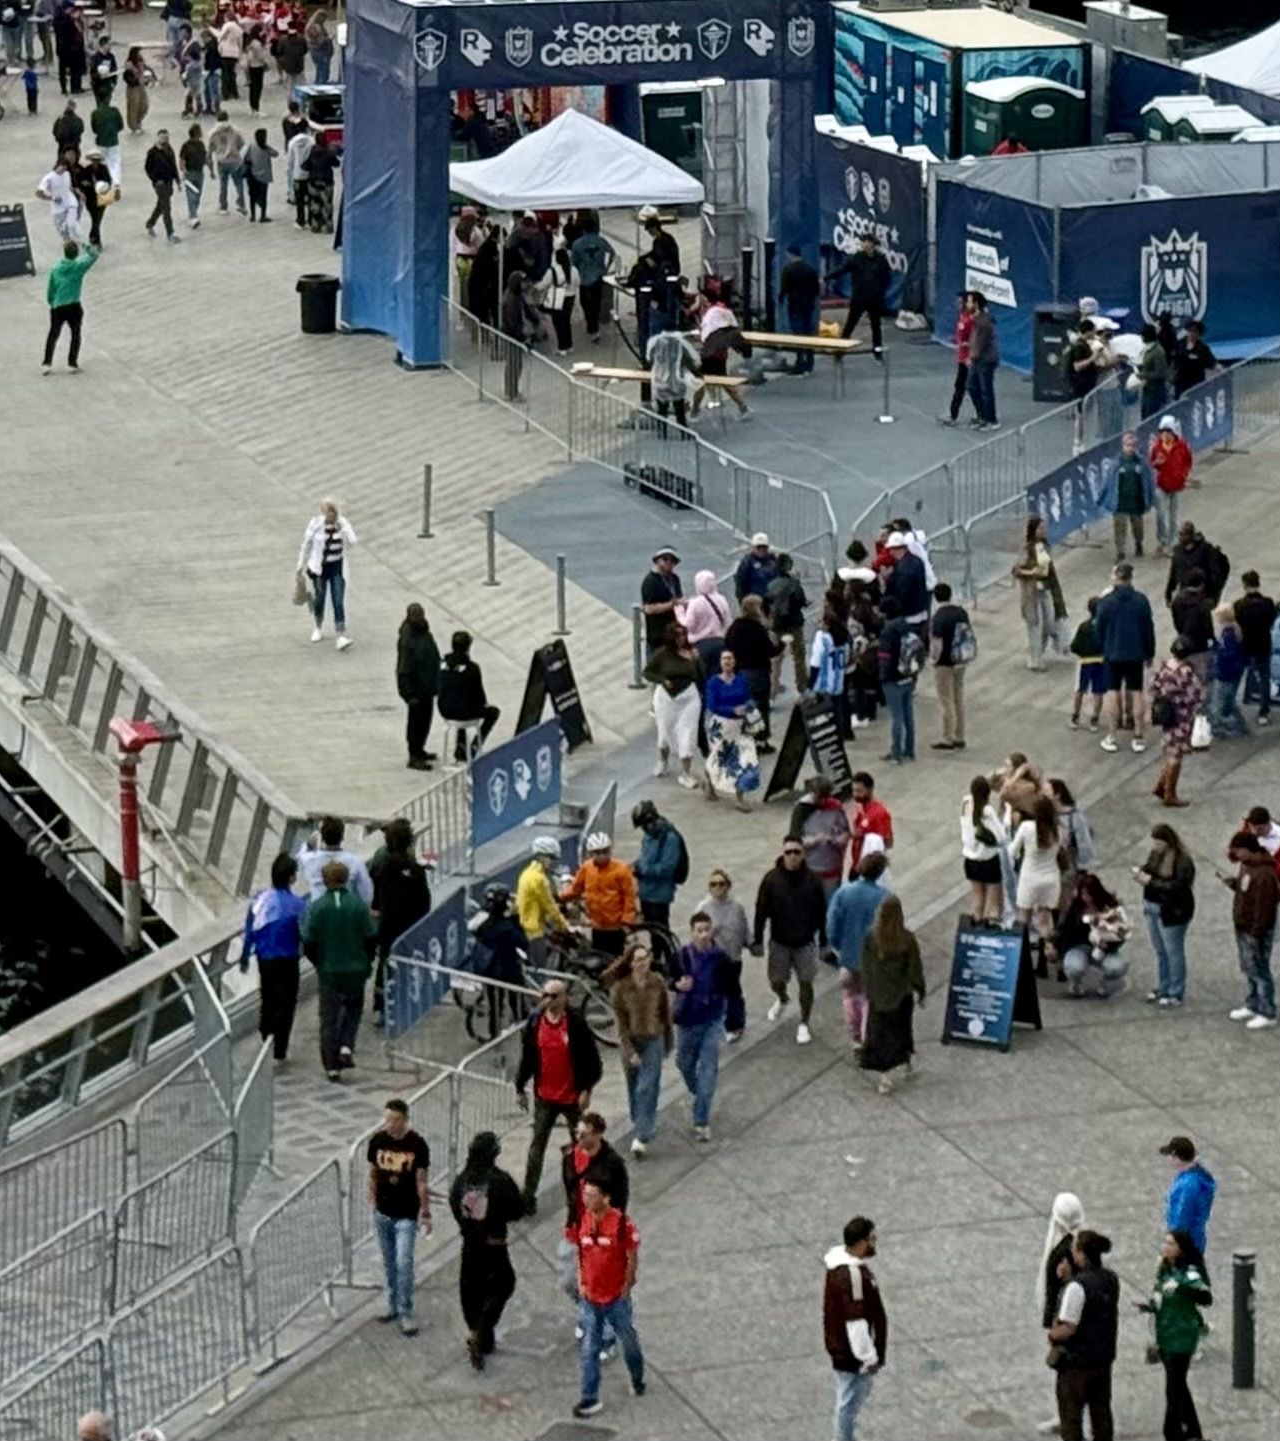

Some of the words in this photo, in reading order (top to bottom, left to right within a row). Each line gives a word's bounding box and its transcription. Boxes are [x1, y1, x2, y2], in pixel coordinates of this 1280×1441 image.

[573, 22, 662, 43] Soccer
[540, 40, 693, 67] Celebration
[846, 207, 890, 241] Soccer
[828, 648, 846, 671] 10
